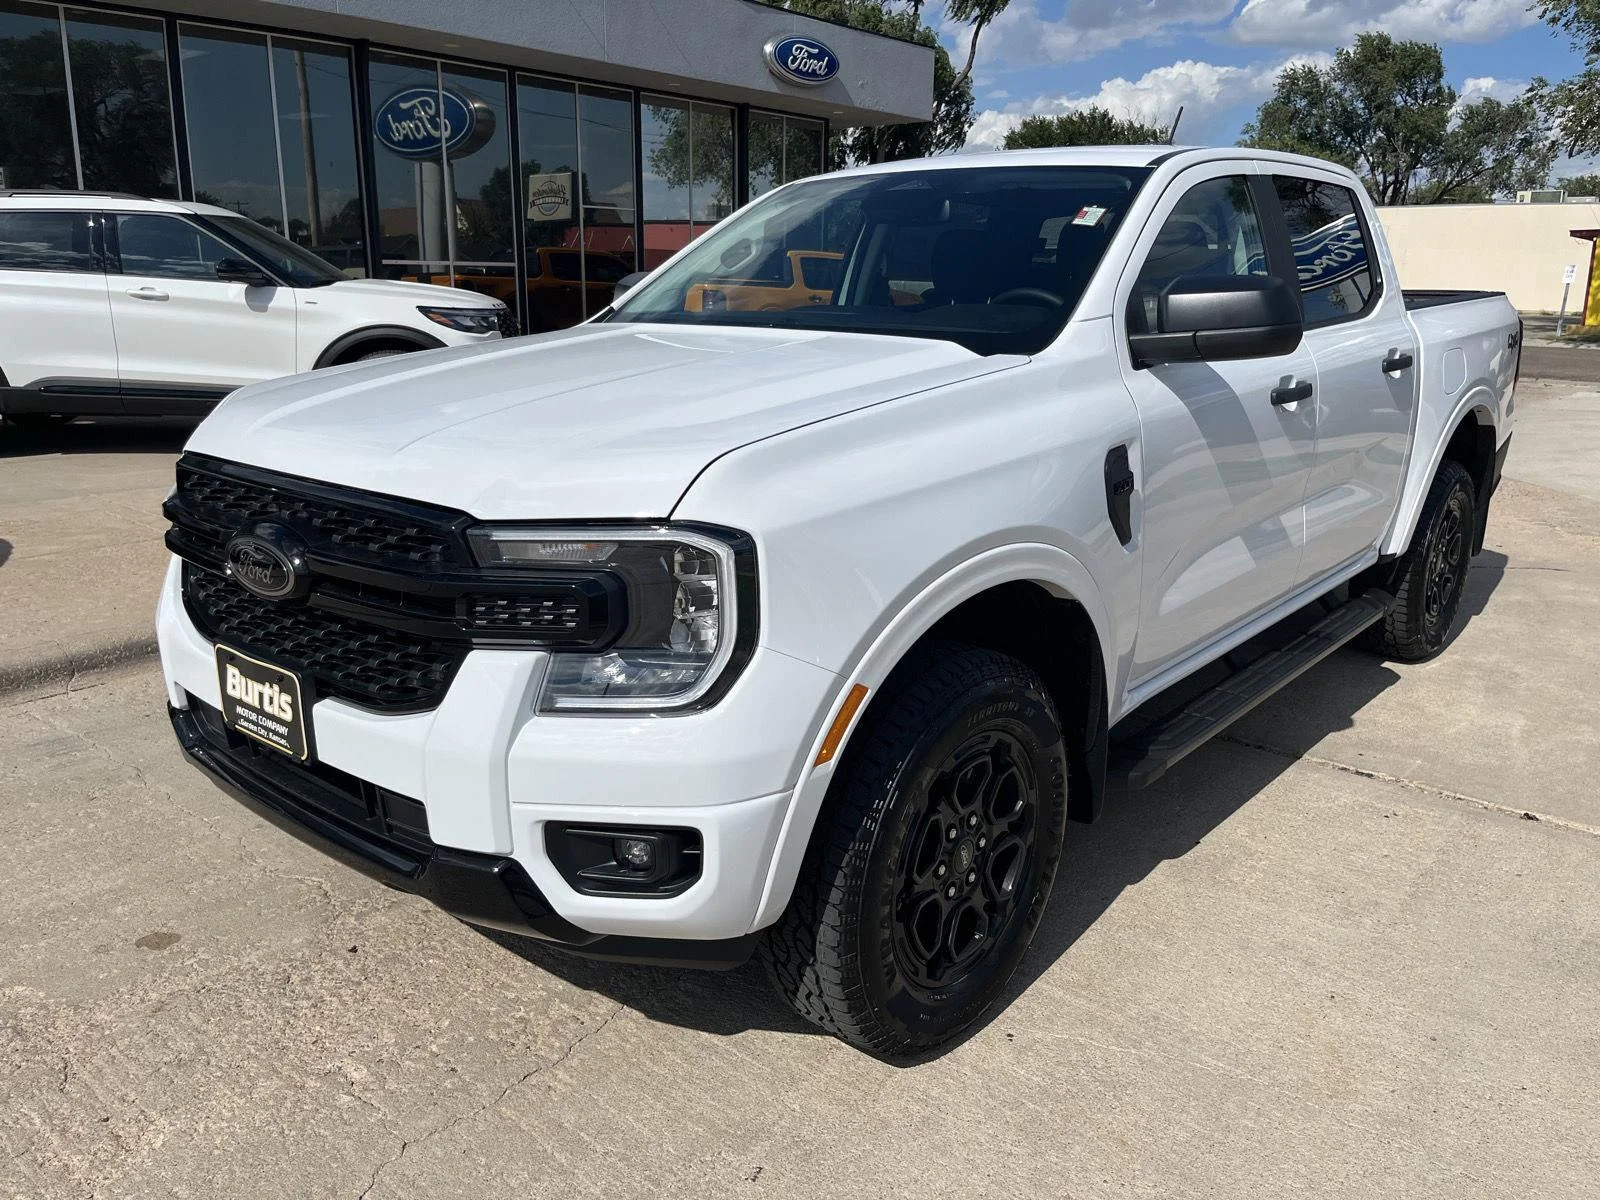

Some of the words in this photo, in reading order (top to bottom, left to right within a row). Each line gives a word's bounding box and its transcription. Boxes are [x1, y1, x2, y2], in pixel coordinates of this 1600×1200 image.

[788, 43, 829, 76] Ford
[238, 547, 274, 585] Ford
[226, 663, 293, 723] Burtis
[236, 704, 258, 721] MOTOR
[258, 716, 289, 736] COMPANY
[240, 718, 258, 732] Garden
[268, 732, 288, 746] Kansas
